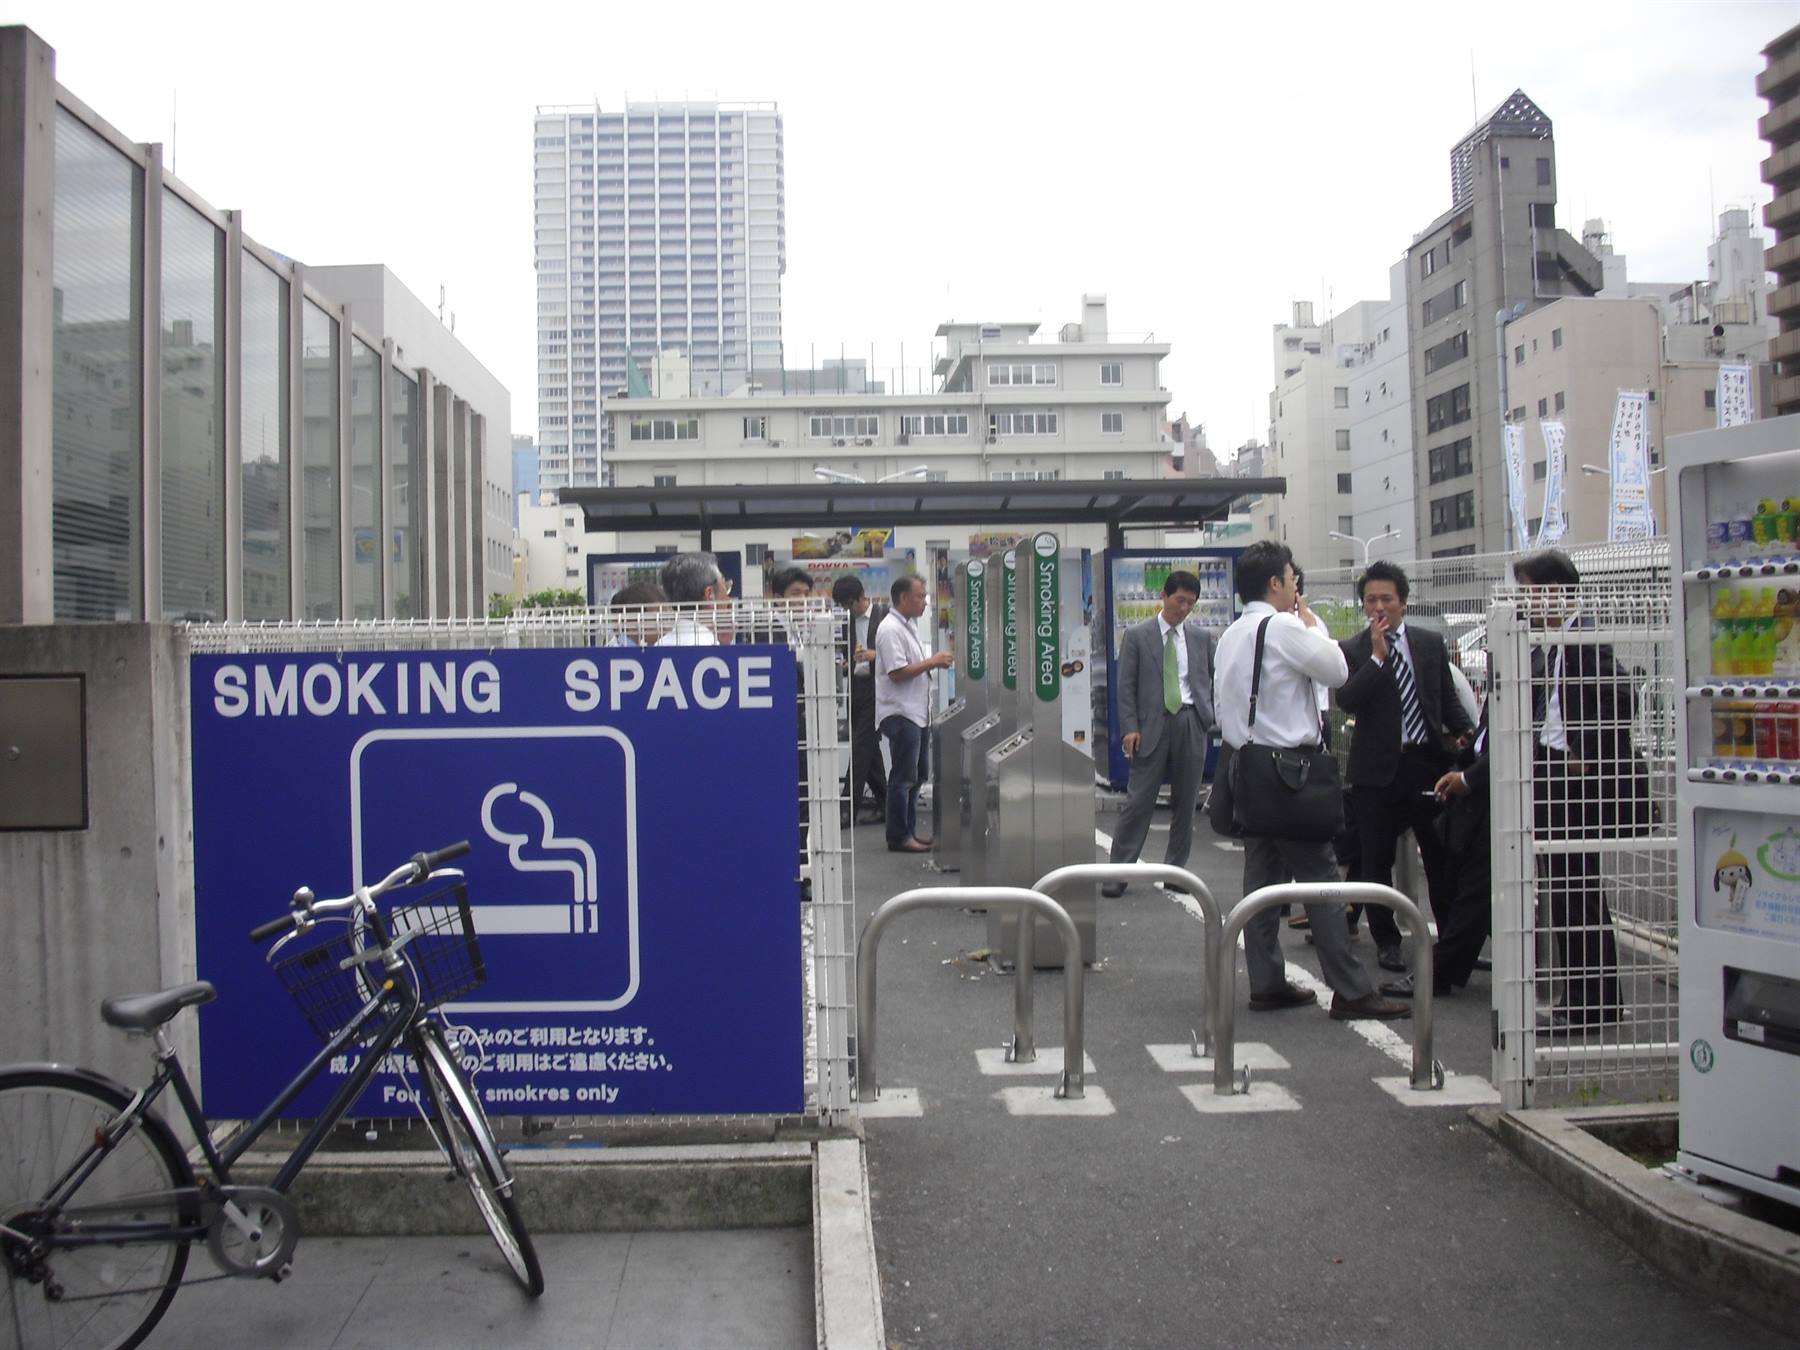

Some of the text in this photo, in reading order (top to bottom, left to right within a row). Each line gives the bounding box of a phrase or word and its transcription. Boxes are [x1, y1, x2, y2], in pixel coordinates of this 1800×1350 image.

[968, 579, 982, 669] Smoking Area
[1037, 561, 1055, 686] Smoking Area
[213, 656, 774, 717] SMOKING SPACE
[1007, 639, 1017, 677] Area
[485, 1084, 570, 1102] smokres
[576, 1084, 620, 1104] only
